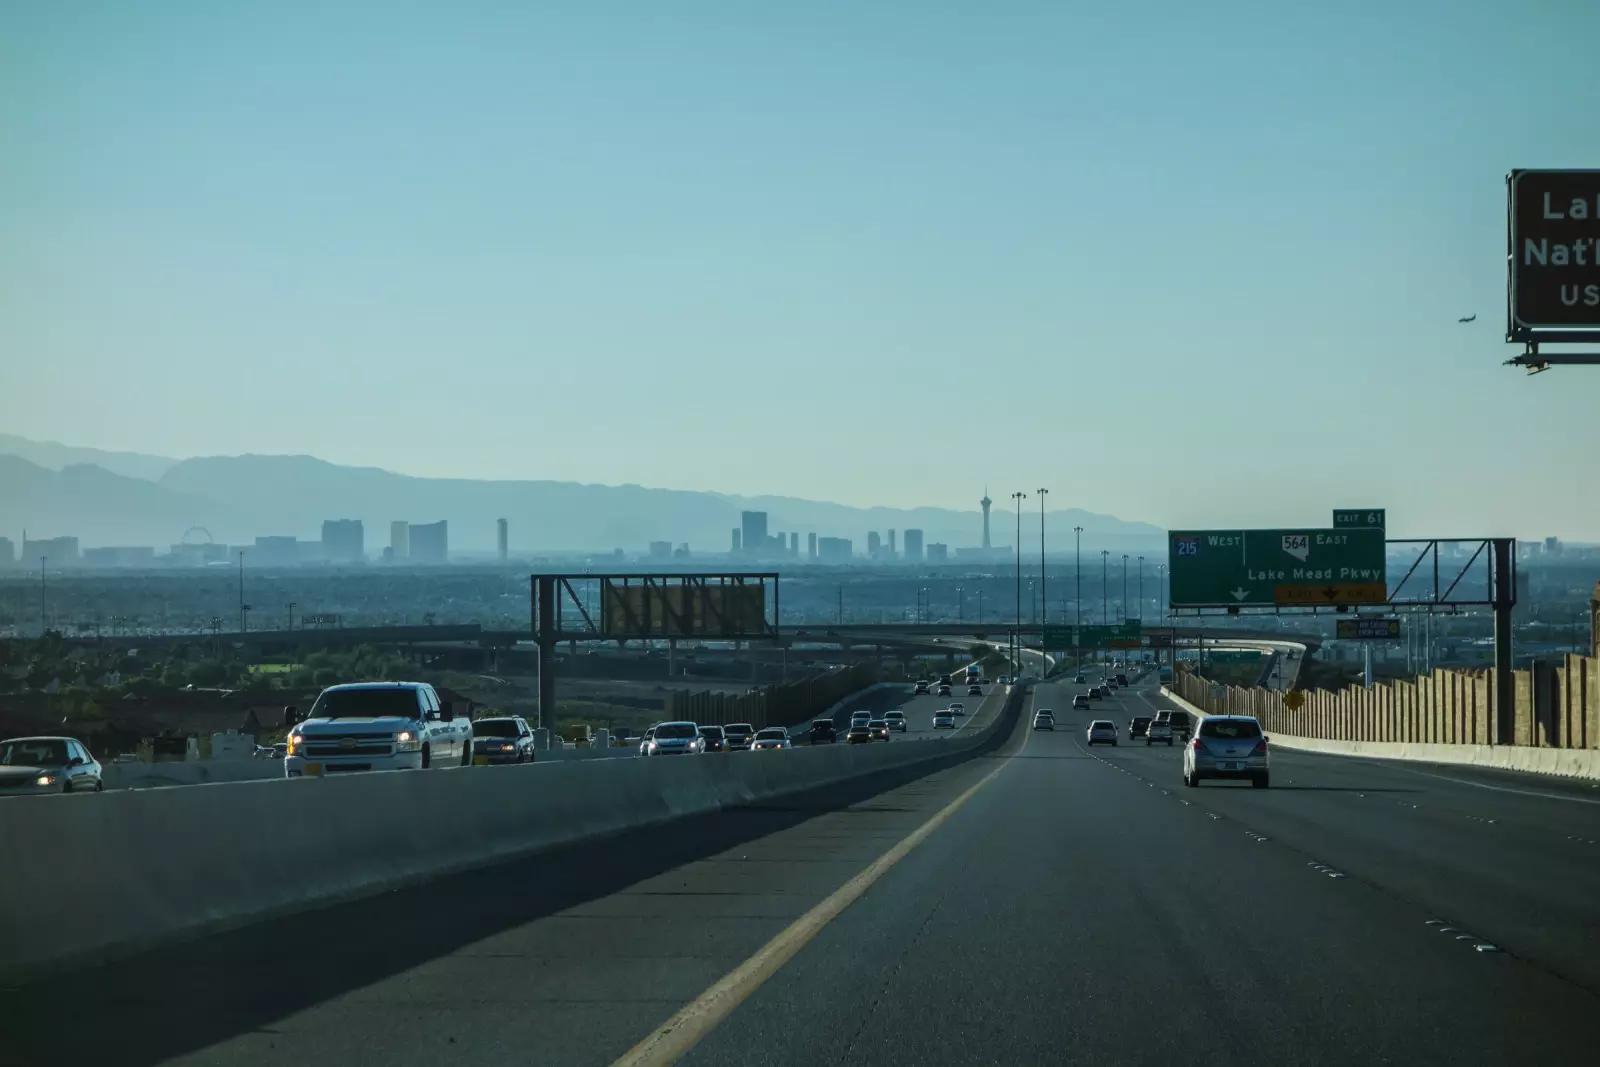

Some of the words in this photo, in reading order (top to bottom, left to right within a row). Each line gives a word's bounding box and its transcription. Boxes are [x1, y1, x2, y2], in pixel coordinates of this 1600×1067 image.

[1543, 191, 1600, 220] La
[1561, 284, 1600, 306] US
[1337, 514, 1360, 523] EXIT
[1367, 511, 1382, 524] 61
[1178, 542, 1197, 556] 215
[1207, 535, 1241, 546] WEST
[1284, 536, 1306, 550] 564
[1316, 534, 1348, 545] EAST
[1248, 567, 1285, 580] Lake
[1293, 567, 1332, 579] Mead
[1340, 567, 1381, 579] Pkwy
